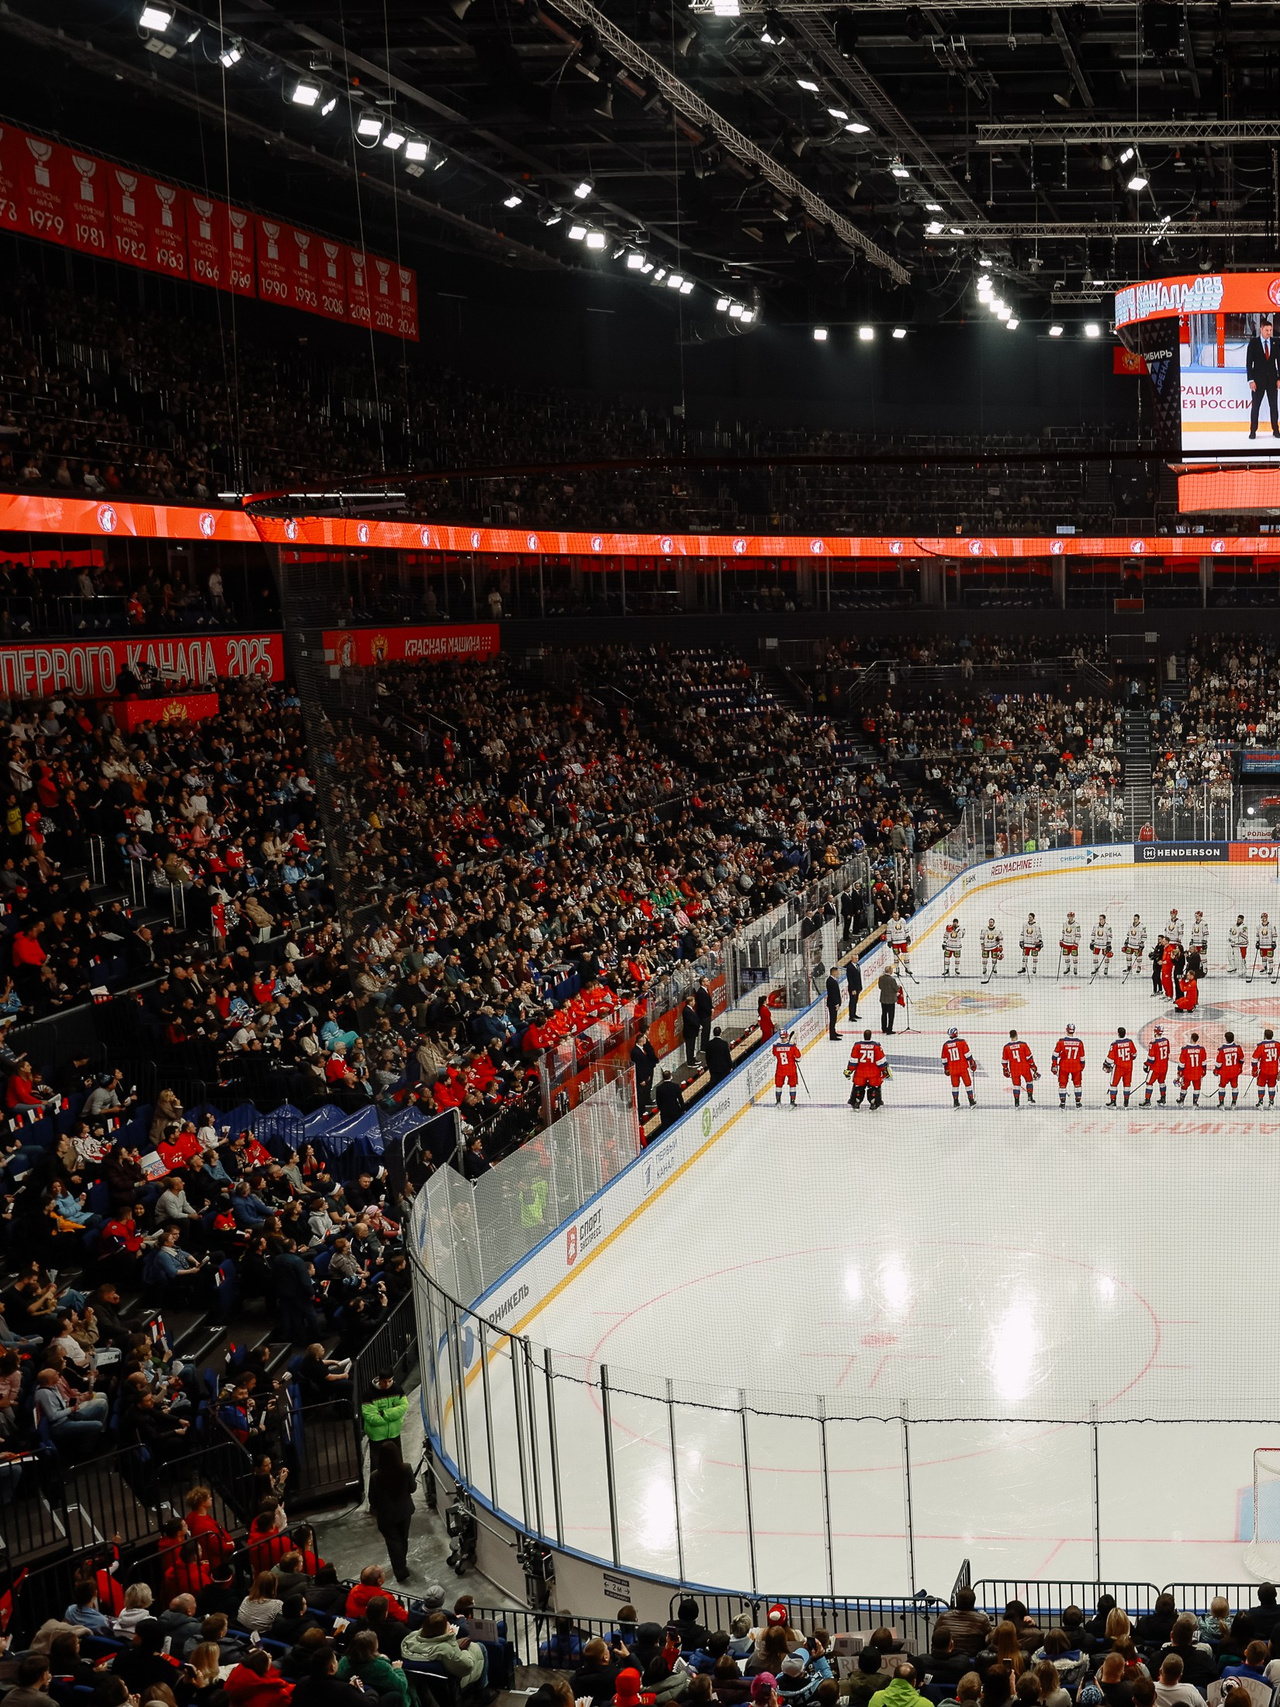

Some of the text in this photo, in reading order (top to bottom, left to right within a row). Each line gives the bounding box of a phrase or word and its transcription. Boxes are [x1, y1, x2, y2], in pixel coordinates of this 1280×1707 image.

[28, 207, 64, 235] 1979
[75, 223, 105, 248] 1981
[116, 235, 147, 261] 1982
[261, 277, 288, 299] 1990
[294, 286, 318, 307] 1993
[1156, 360, 1170, 395] АРЕНА
[404, 635, 480, 657] КРАСНАЯ МАШИНА
[0, 646, 118, 699] ПЕРВОГО
[227, 638, 272, 682] 2025
[1157, 848, 1221, 857] HENDERSON
[780, 1053, 788, 1065] 8
[859, 1050, 874, 1063] 29
[947, 1047, 960, 1061] 10
[1012, 1050, 1021, 1062] 4
[1064, 1046, 1078, 1059] 77
[1118, 1048, 1131, 1062] 45
[1160, 1046, 1169, 1060] 13
[1264, 1048, 1278, 1062] 34
[1189, 1054, 1200, 1067] 11
[1224, 1053, 1238, 1067] 87
[579, 1207, 603, 1240] СПОРТ
